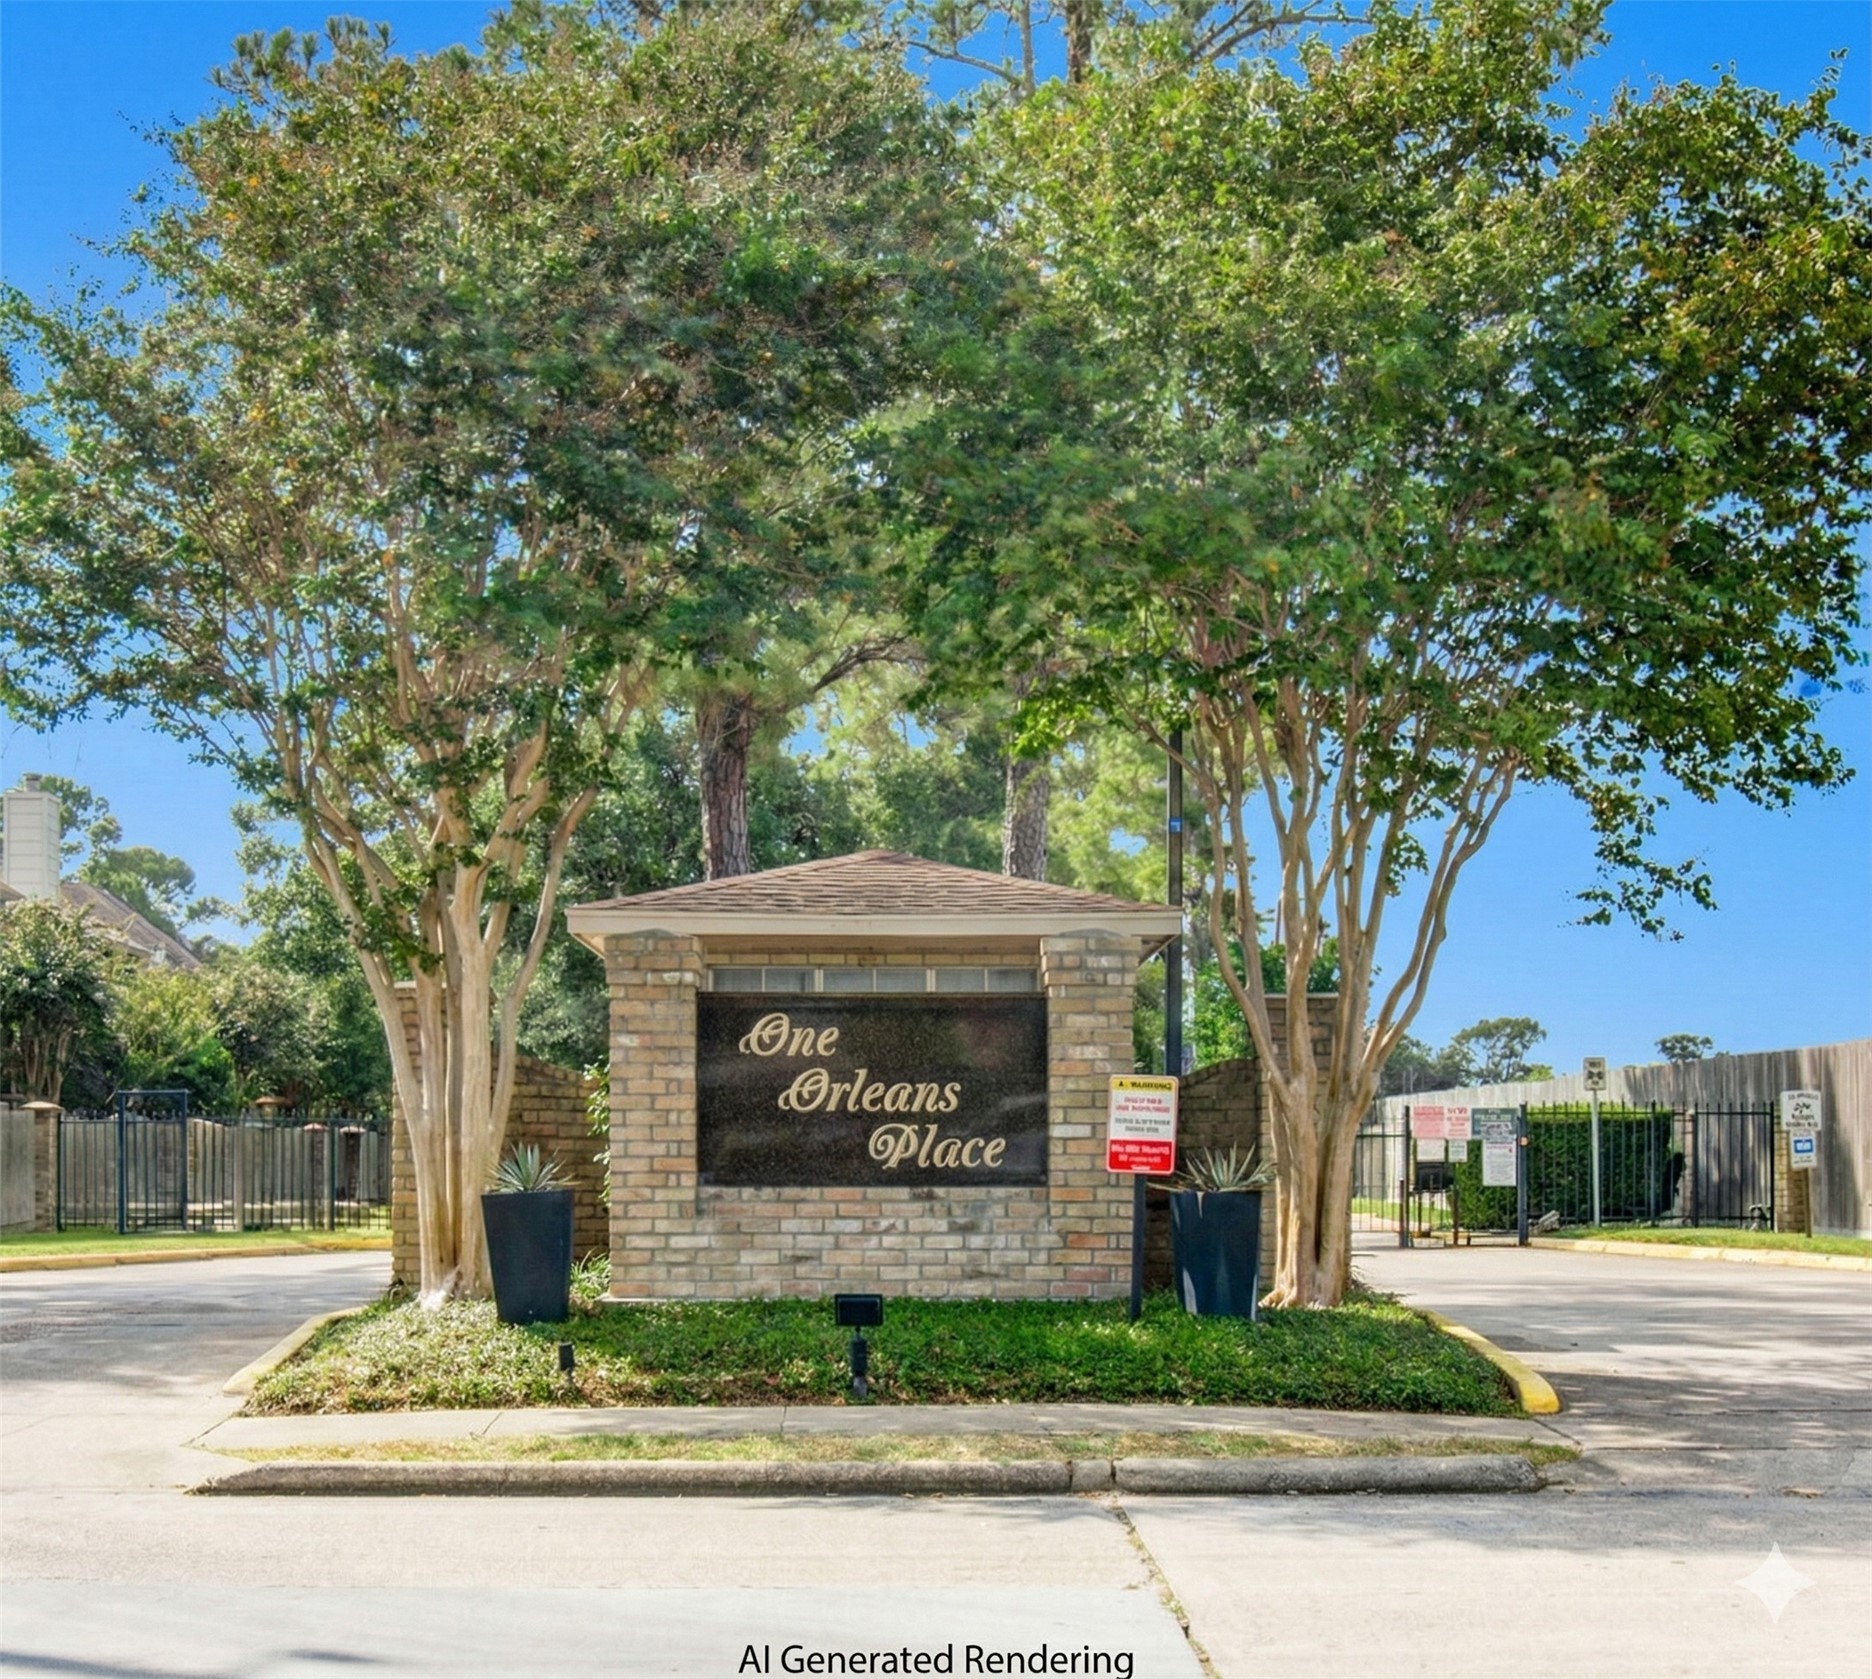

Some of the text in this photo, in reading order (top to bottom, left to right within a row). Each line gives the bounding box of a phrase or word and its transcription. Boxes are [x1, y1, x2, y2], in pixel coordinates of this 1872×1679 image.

[738, 1012, 840, 1057] One
[777, 1067, 961, 1114] Orleans
[868, 1123, 1006, 1170] Place
